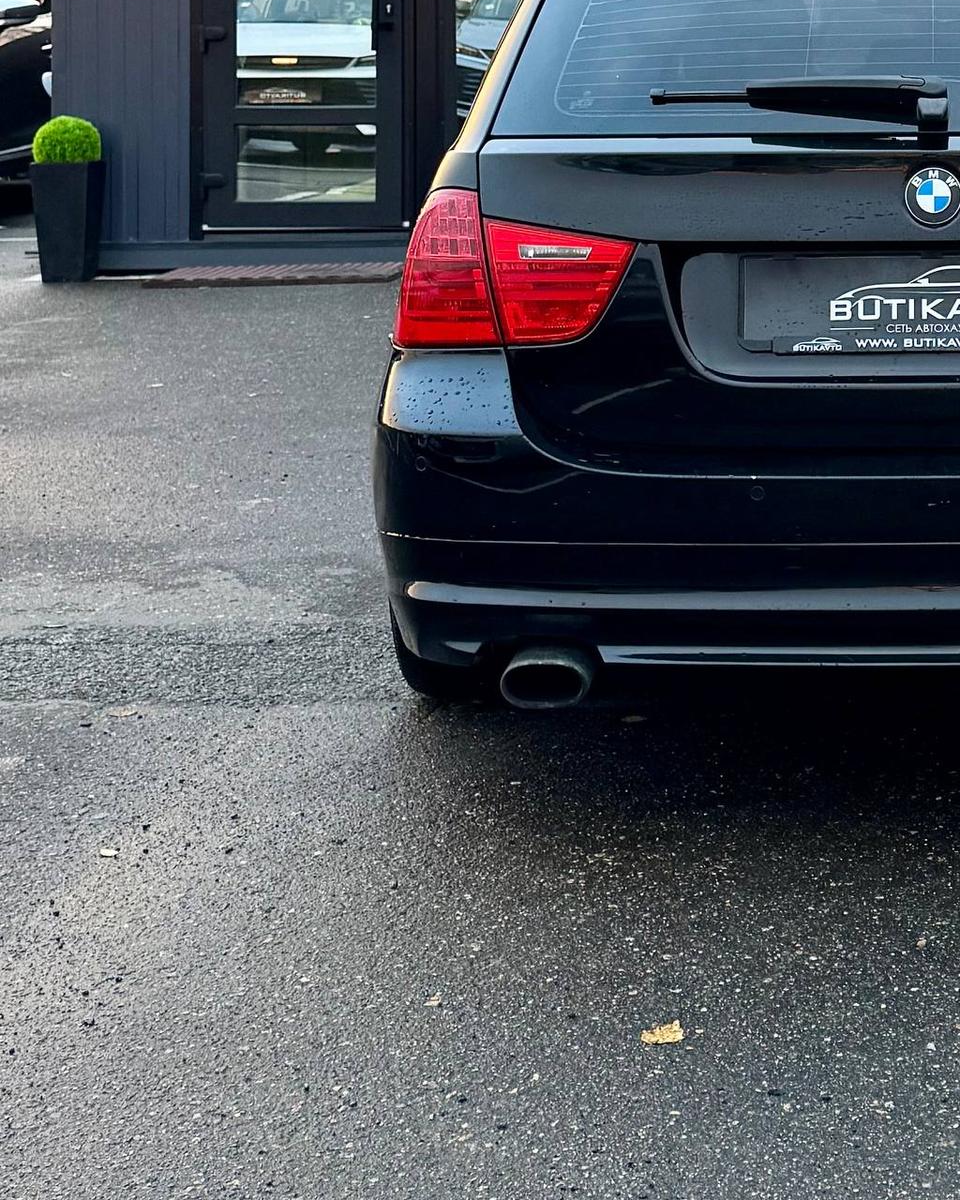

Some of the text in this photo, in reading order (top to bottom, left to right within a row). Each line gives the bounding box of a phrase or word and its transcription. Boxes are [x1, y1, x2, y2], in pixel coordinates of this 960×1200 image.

[911, 170, 958, 188] BMW
[886, 324, 912, 333] СЕТЬ
[855, 339, 898, 348] WWW.
